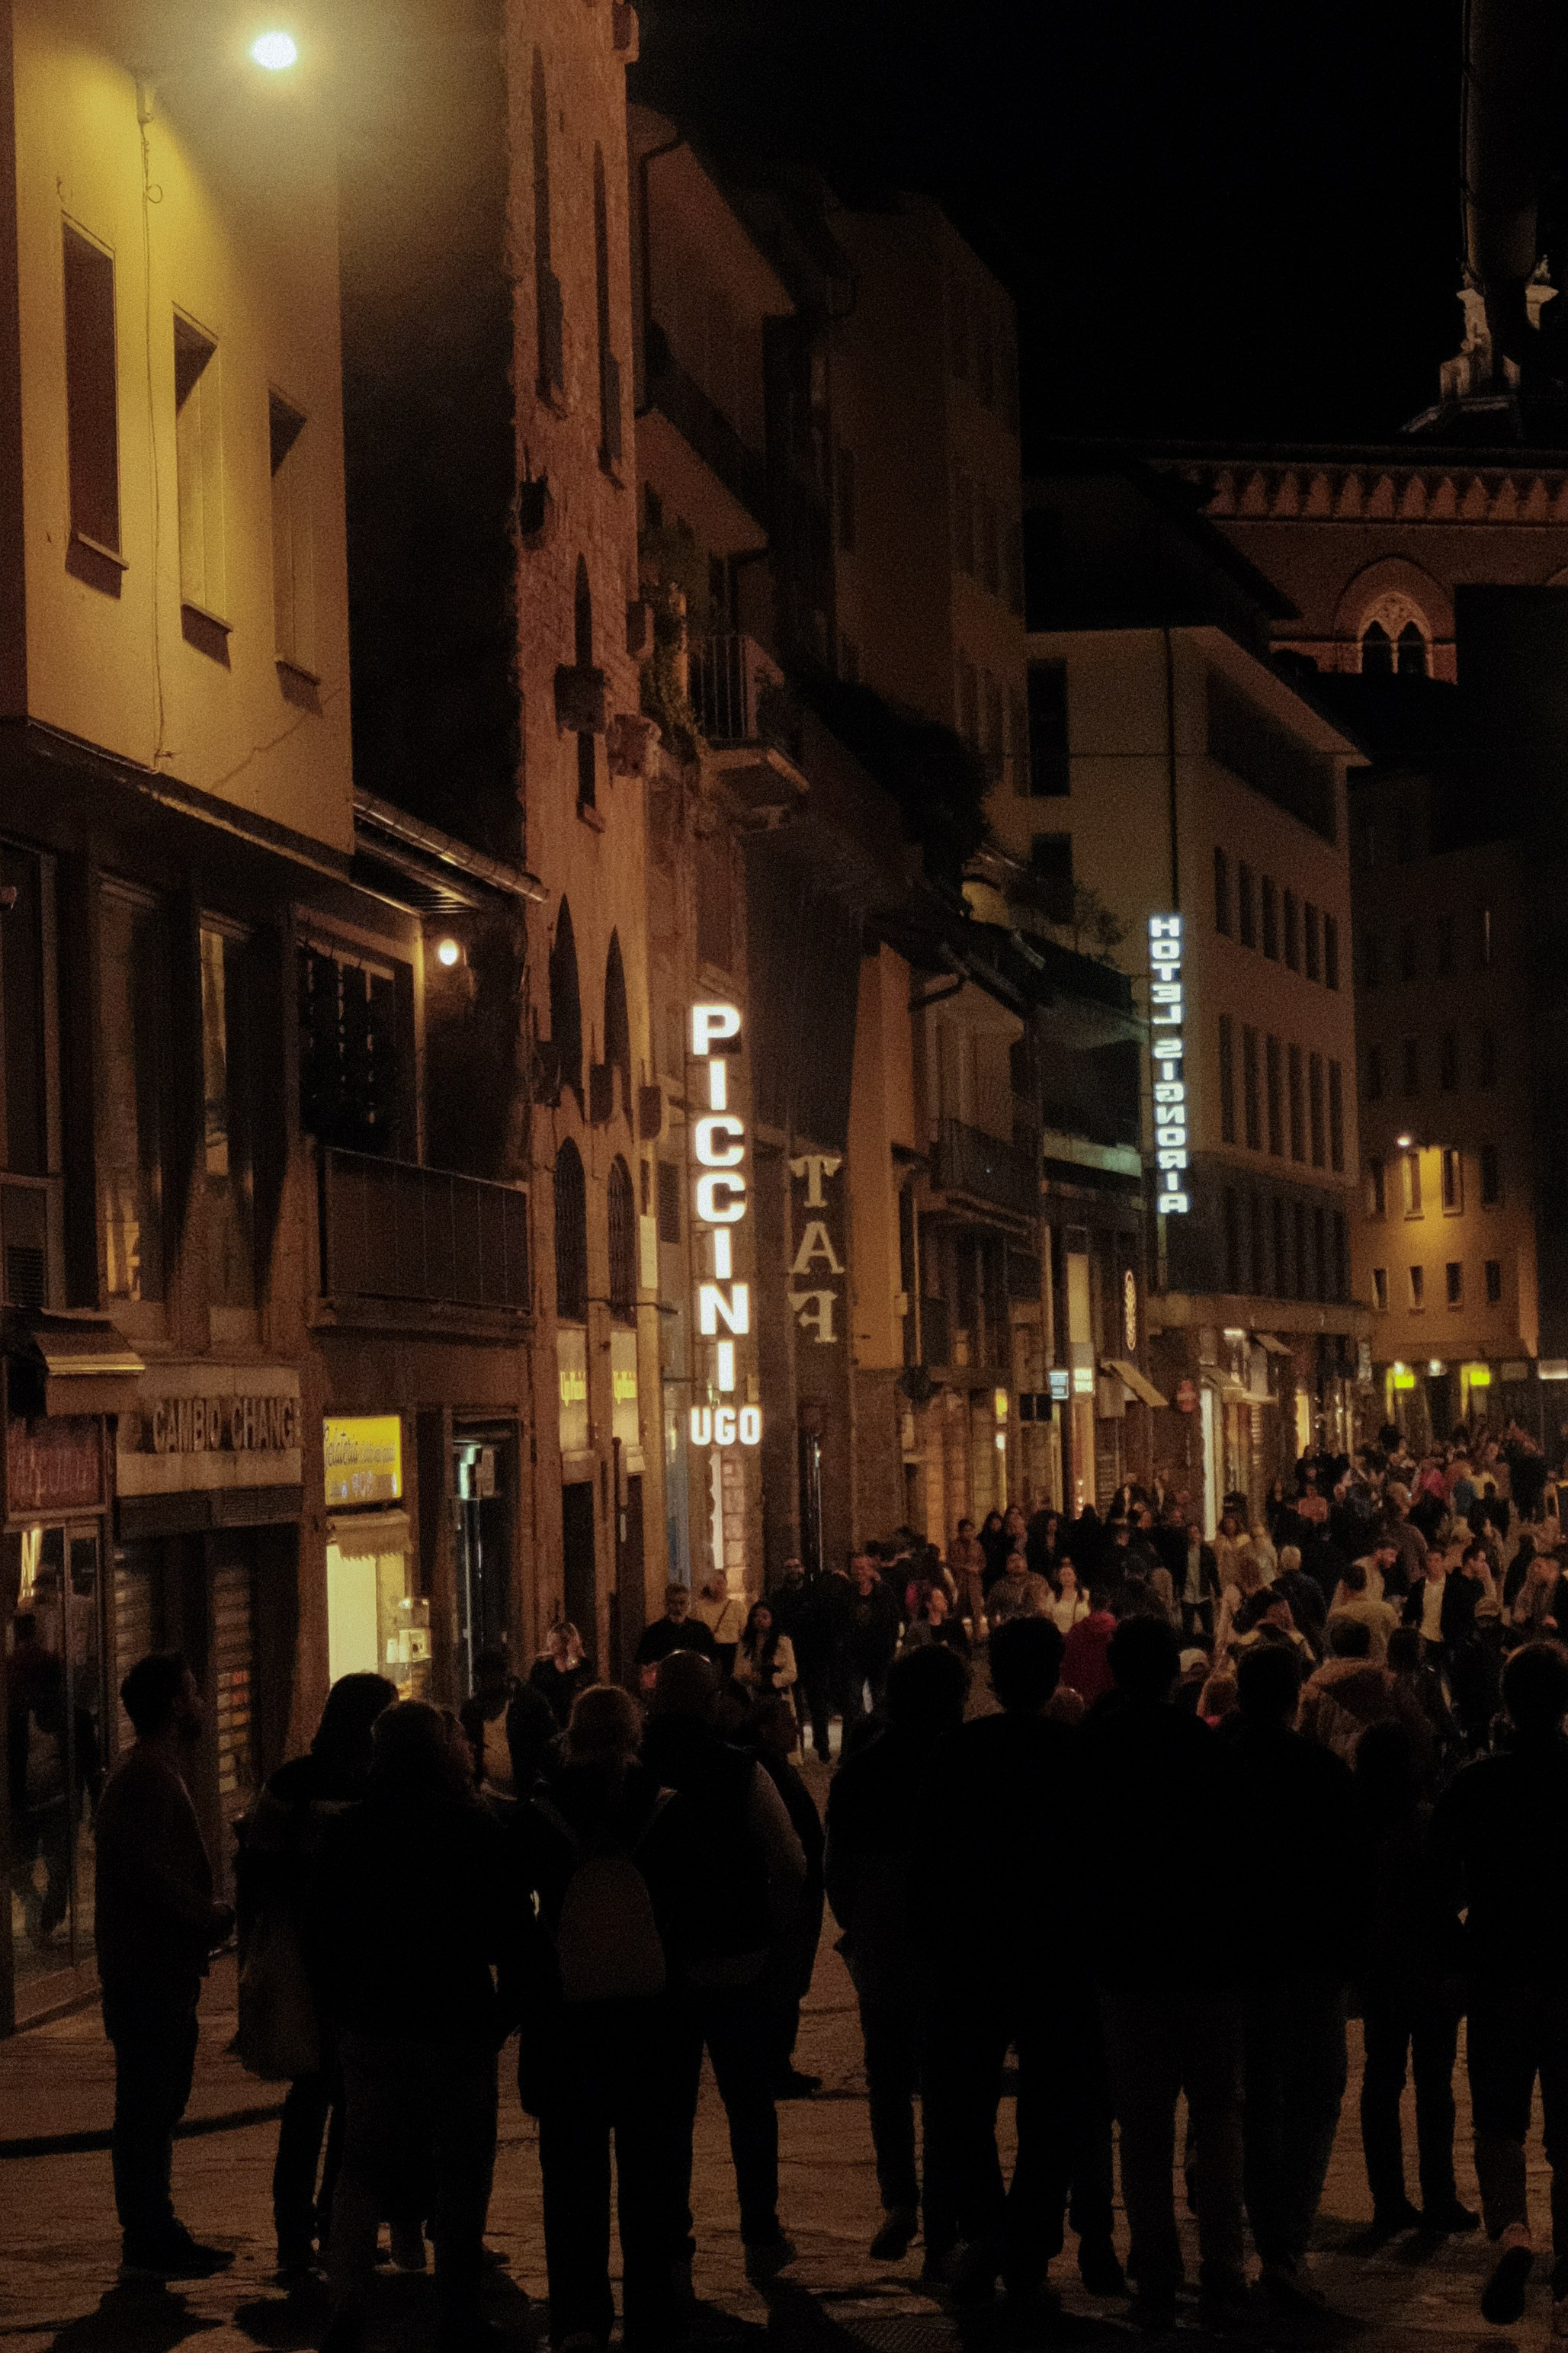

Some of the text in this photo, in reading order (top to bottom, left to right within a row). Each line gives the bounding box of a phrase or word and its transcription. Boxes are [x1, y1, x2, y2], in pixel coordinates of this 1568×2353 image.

[690, 1003, 750, 1392] PICCINI
[153, 1398, 221, 1454] CAMBIO
[691, 1406, 762, 1446] UGO
